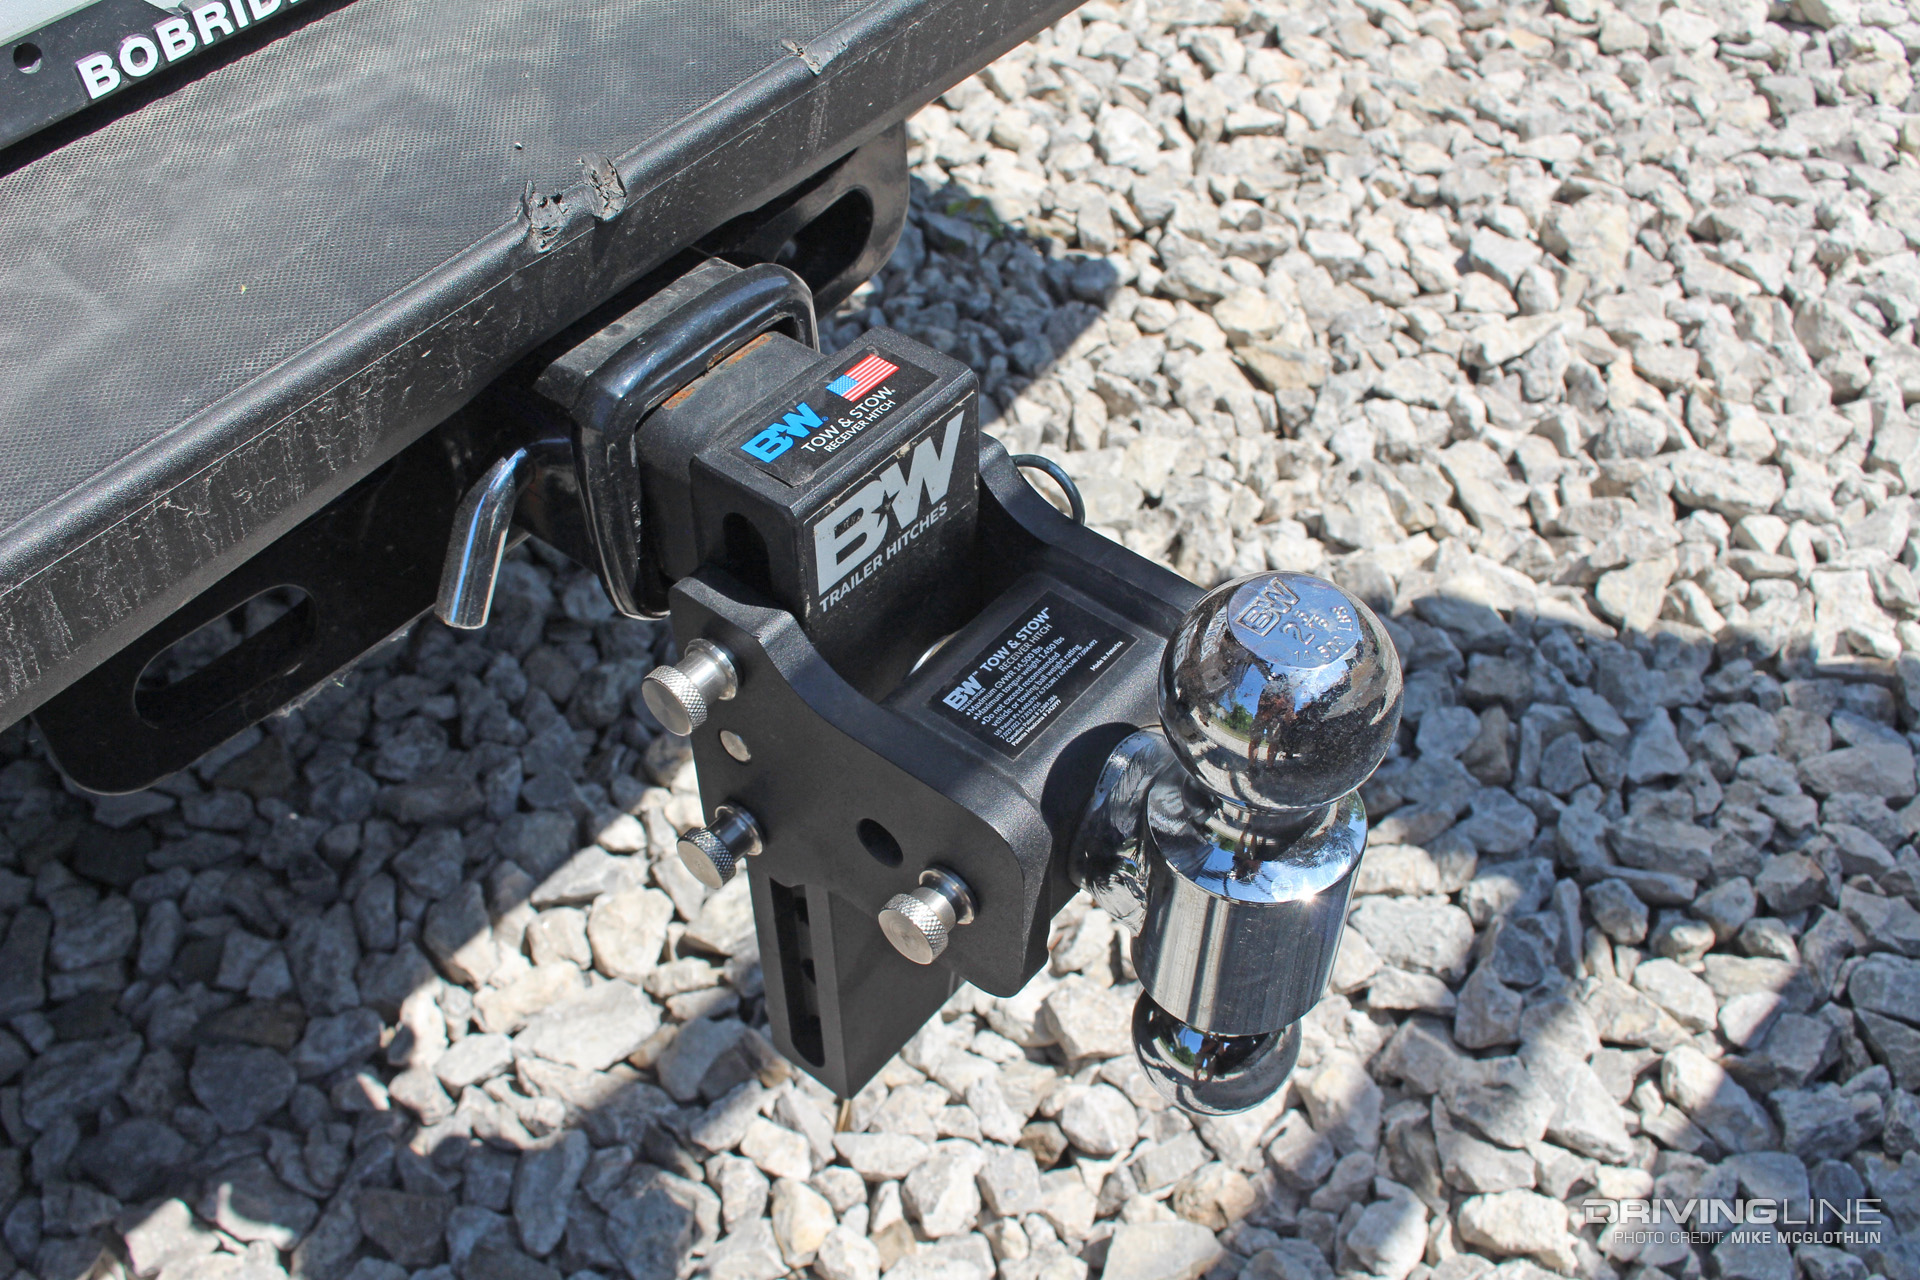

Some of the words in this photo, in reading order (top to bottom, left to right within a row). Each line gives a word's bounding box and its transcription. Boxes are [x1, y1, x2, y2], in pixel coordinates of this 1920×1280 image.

[76, 0, 299, 99] BOBRID
[801, 424, 840, 453] TOW
[838, 418, 854, 428] &
[823, 420, 870, 452] RECEIVER
[867, 399, 896, 422] HITCH
[819, 555, 883, 613] TRAILER
[886, 501, 948, 561] HITCHES
[979, 646, 1010, 672] TOW
[1007, 639, 1021, 649] &
[998, 642, 1033, 672] RECEIVER
[1028, 623, 1053, 644] HITCH
[1089, 659, 1104, 672] Made
[1105, 641, 1124, 657] America
[1282, 620, 1316, 645] 2
[967, 687, 998, 714] Maximum
[994, 670, 1017, 689] GVWR
[1013, 652, 1035, 672] 14,500
[1031, 645, 1044, 655] lbs
[974, 692, 1005, 718] Maximum
[1001, 674, 1024, 694] tongue
[1020, 657, 1042, 676] weight
[1038, 643, 1057, 659] 1,450
[1052, 636, 1065, 646] lbs
[982, 713, 995, 723] Do
[993, 703, 1006, 715] not
[1003, 685, 1025, 705] exceed
[1022, 651, 1061, 688] recommended
[991, 708, 1013, 727] vehicle
[1011, 701, 1020, 709] or
[1016, 684, 1040, 703] towing
[1034, 674, 1049, 686] ball
[1045, 658, 1067, 676] weight
[1063, 644, 1083, 660] rating
